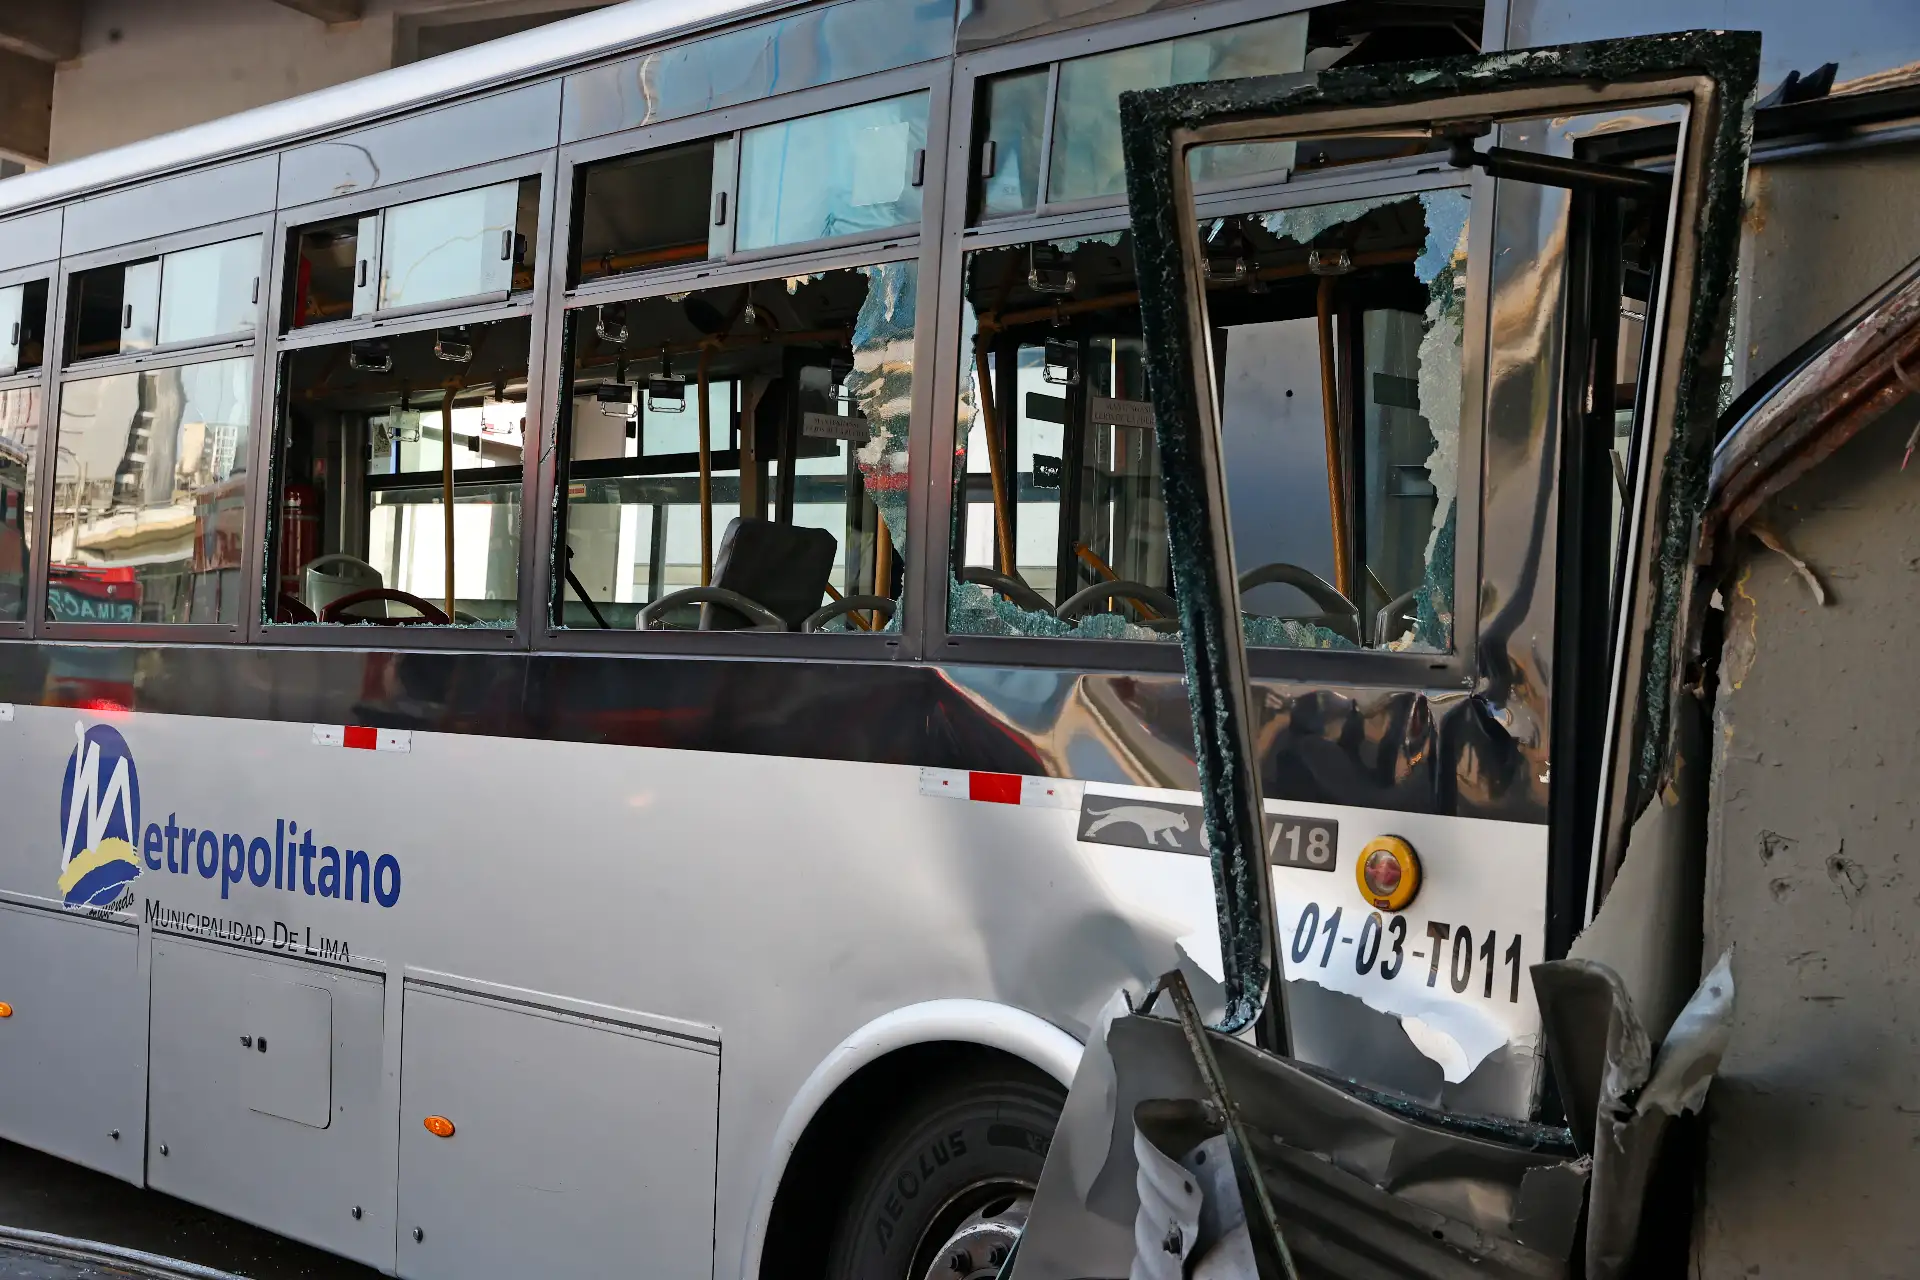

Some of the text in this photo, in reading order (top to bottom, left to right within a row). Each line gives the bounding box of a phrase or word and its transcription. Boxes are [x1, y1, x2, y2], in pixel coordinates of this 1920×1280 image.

[144, 898, 266, 946] MUNICIPALIDAD
[1291, 902, 1523, 1003] 01-03-T011
[876, 1129, 967, 1255] AEOLUS
